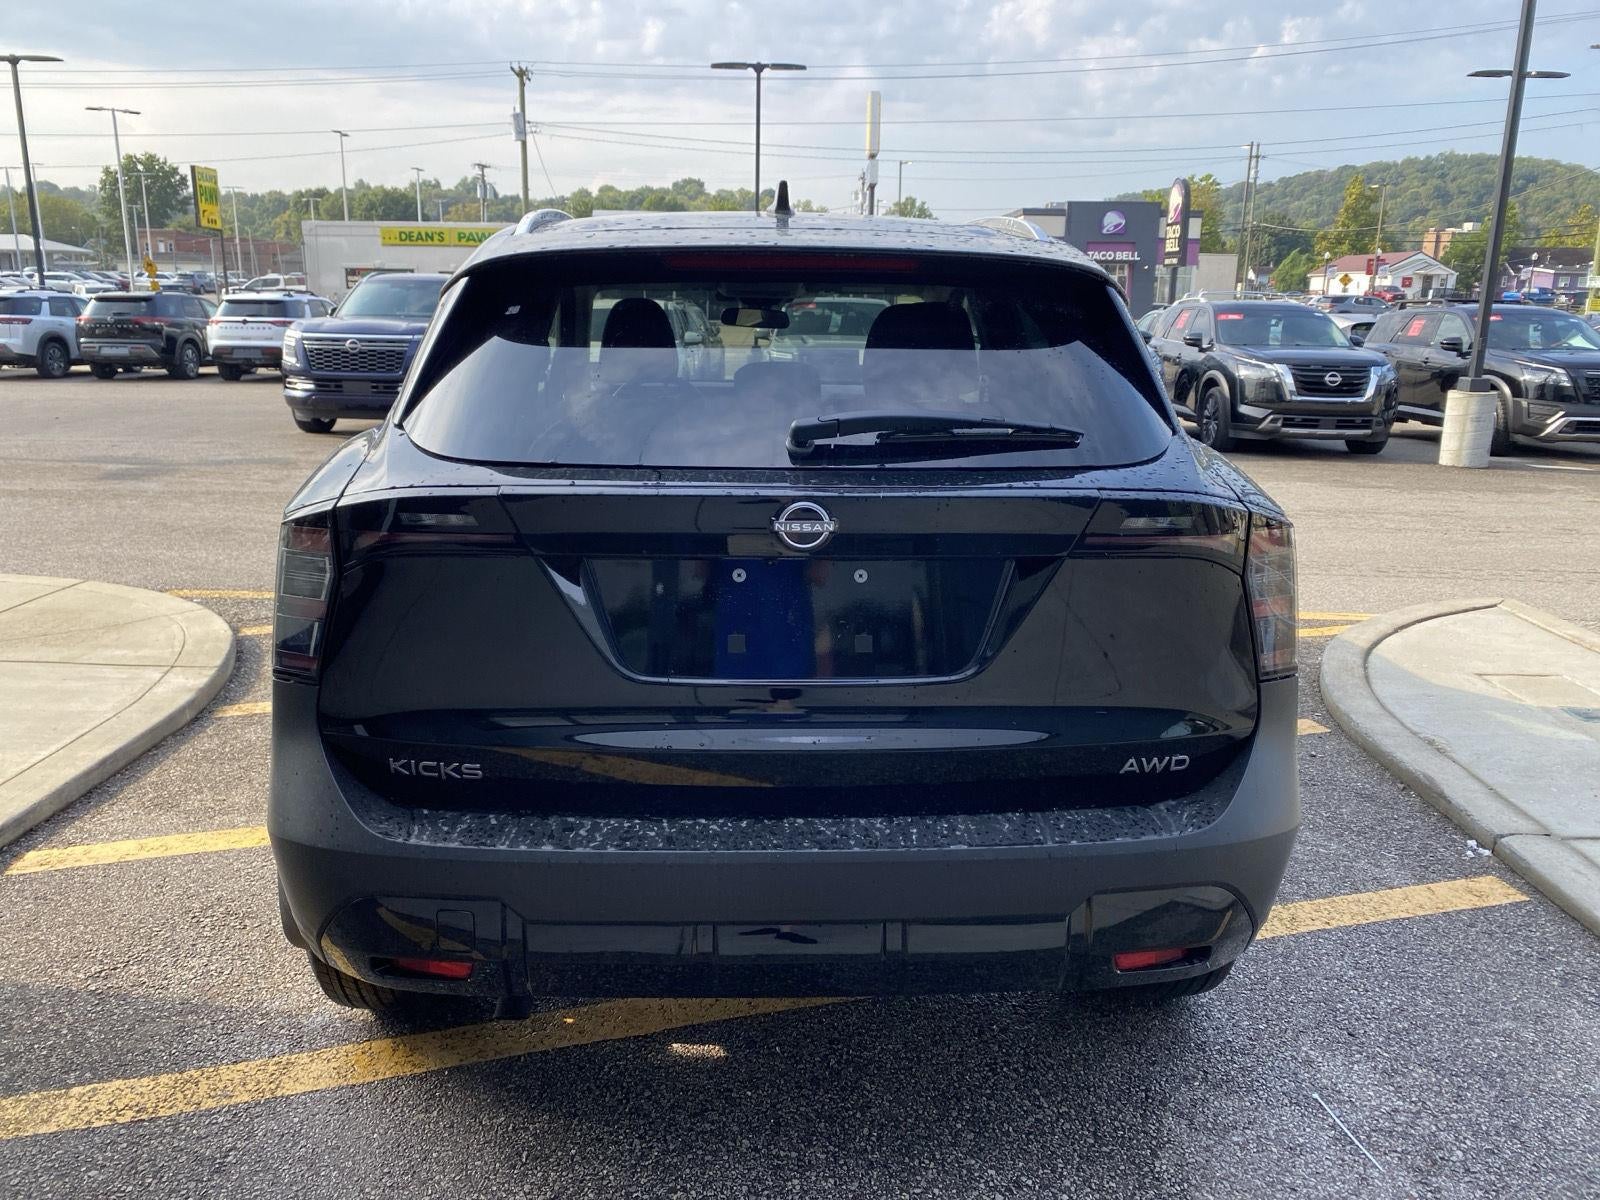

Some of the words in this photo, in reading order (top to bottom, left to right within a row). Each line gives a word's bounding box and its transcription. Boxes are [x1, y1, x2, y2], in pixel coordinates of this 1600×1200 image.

[399, 231, 445, 243] DEAN'S
[457, 231, 494, 243] PAW
[1166, 225, 1181, 239] TACO
[1165, 239, 1180, 253] BELL
[1087, 251, 1115, 260] TACO
[1116, 251, 1141, 261] BELL
[775, 523, 833, 531] NISSAN
[389, 758, 483, 779] KICKS
[1120, 755, 1190, 774] AWD
